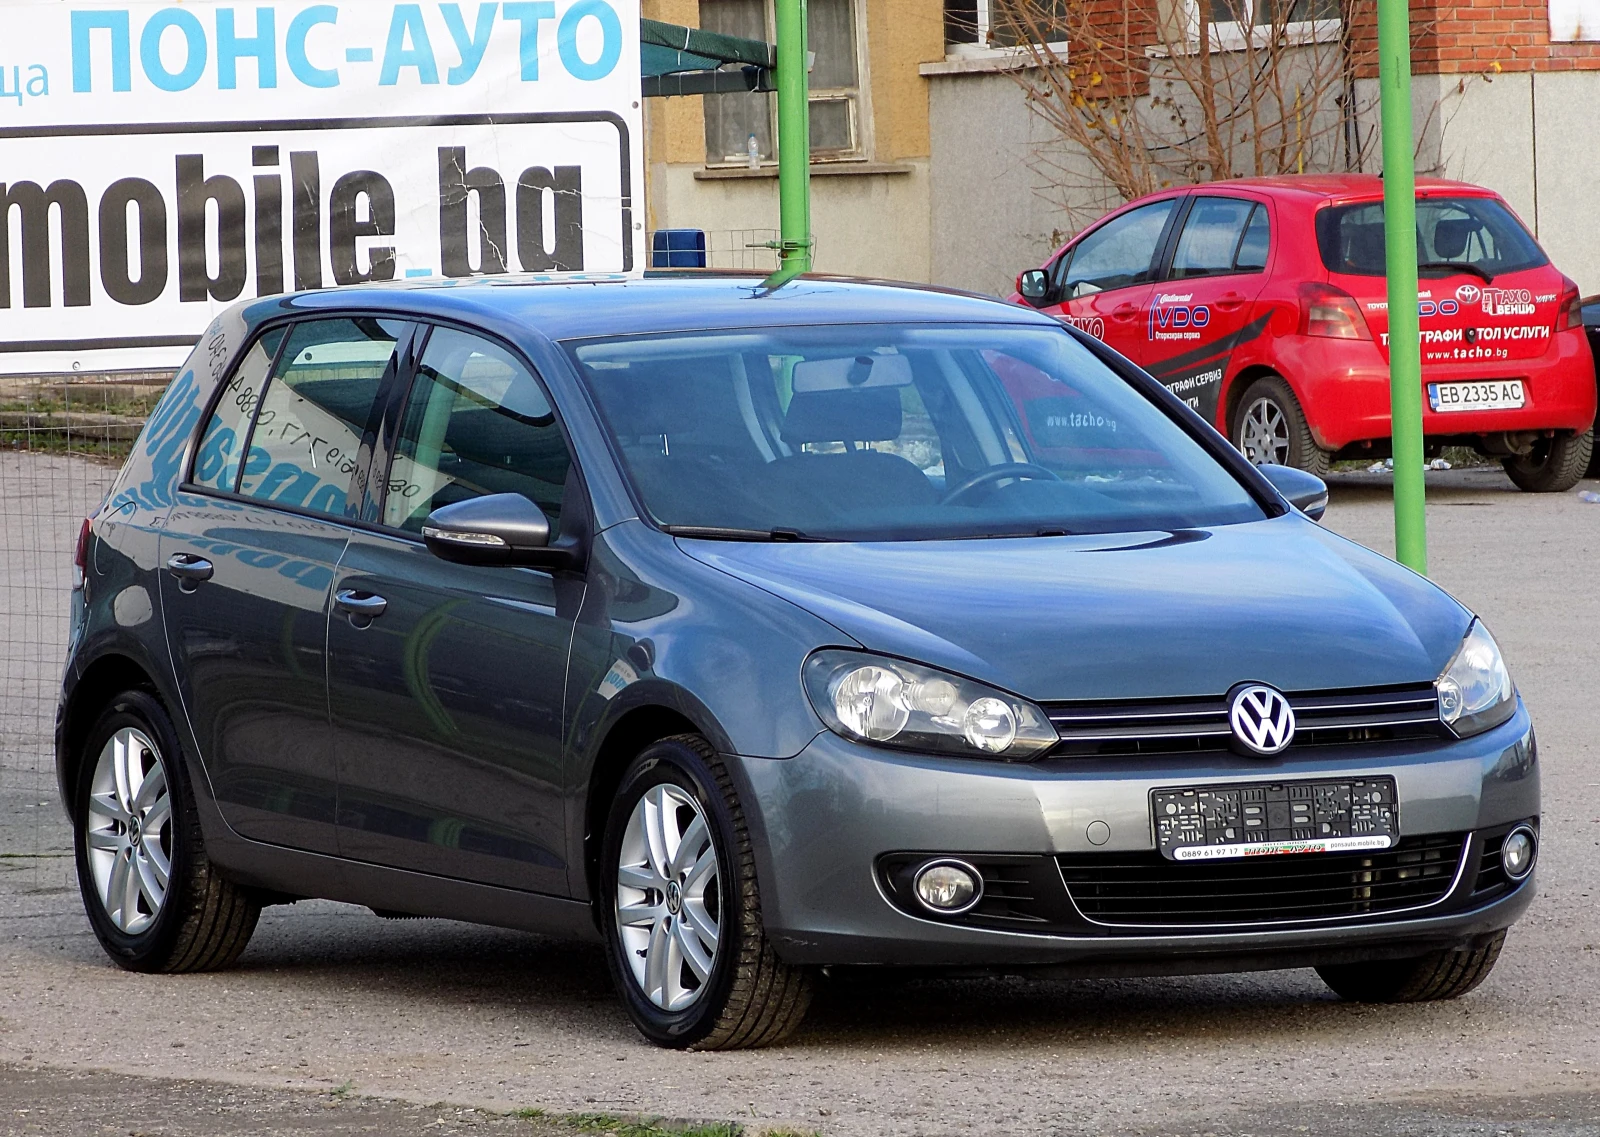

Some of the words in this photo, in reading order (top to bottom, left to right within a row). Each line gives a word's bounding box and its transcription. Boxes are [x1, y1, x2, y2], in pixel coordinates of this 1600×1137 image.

[70, 0, 622, 92] ПОНС-АУТО
[1155, 305, 1210, 328] VDO
[1183, 332, 1200, 341] сервиз
[1477, 327, 1500, 340] ТОЛ
[1503, 326, 1549, 339] УСЛУГИ
[1427, 346, 1508, 358] www.tacho.bg
[1195, 368, 1222, 387] СЕРВИЗ
[1440, 386, 1460, 403] EB
[1462, 385, 1498, 402] 2335
[1502, 383, 1520, 400] AC
[1330, 839, 1385, 849] ponsauto.mobile.bg
[1181, 850, 1202, 858] 0889
[1204, 849, 1214, 857] 61
[1216, 848, 1226, 856] 97
[1229, 847, 1238, 855] 17
